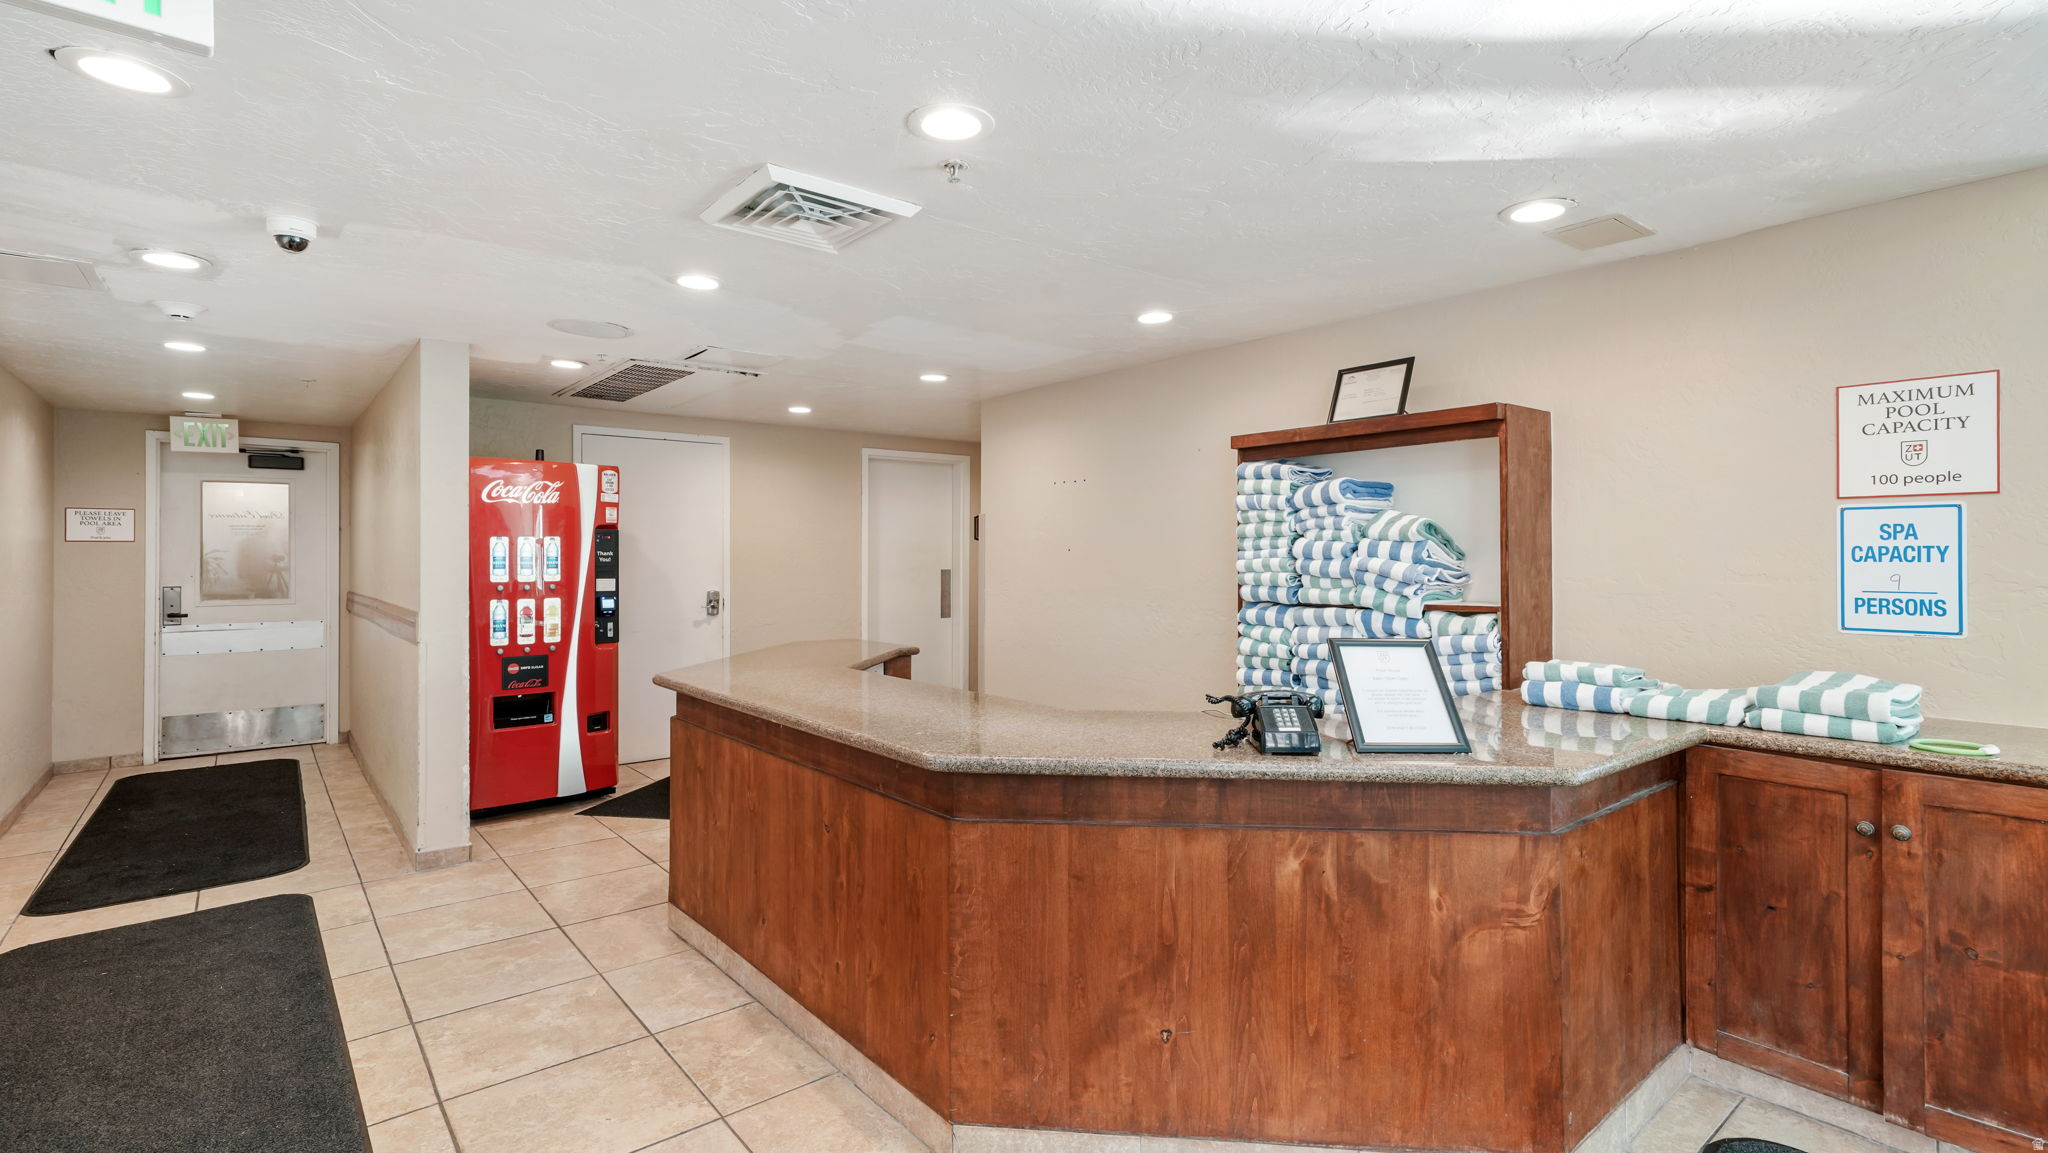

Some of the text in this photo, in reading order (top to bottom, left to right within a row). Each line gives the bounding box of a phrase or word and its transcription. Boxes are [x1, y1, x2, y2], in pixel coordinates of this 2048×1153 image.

[1857, 383, 1975, 406] MAXIMUM
[1885, 403, 1945, 418] POOL
[183, 421, 229, 448] EXIT
[1862, 416, 1970, 436] CAPACITY
[1871, 470, 1963, 486] 100 people
[481, 480, 565, 504] Coca-Cola
[1879, 523, 1918, 540] SPA
[1851, 545, 1950, 563] CAPACITY
[1890, 574, 1901, 590] 9
[1854, 597, 1947, 617] PERSONS
